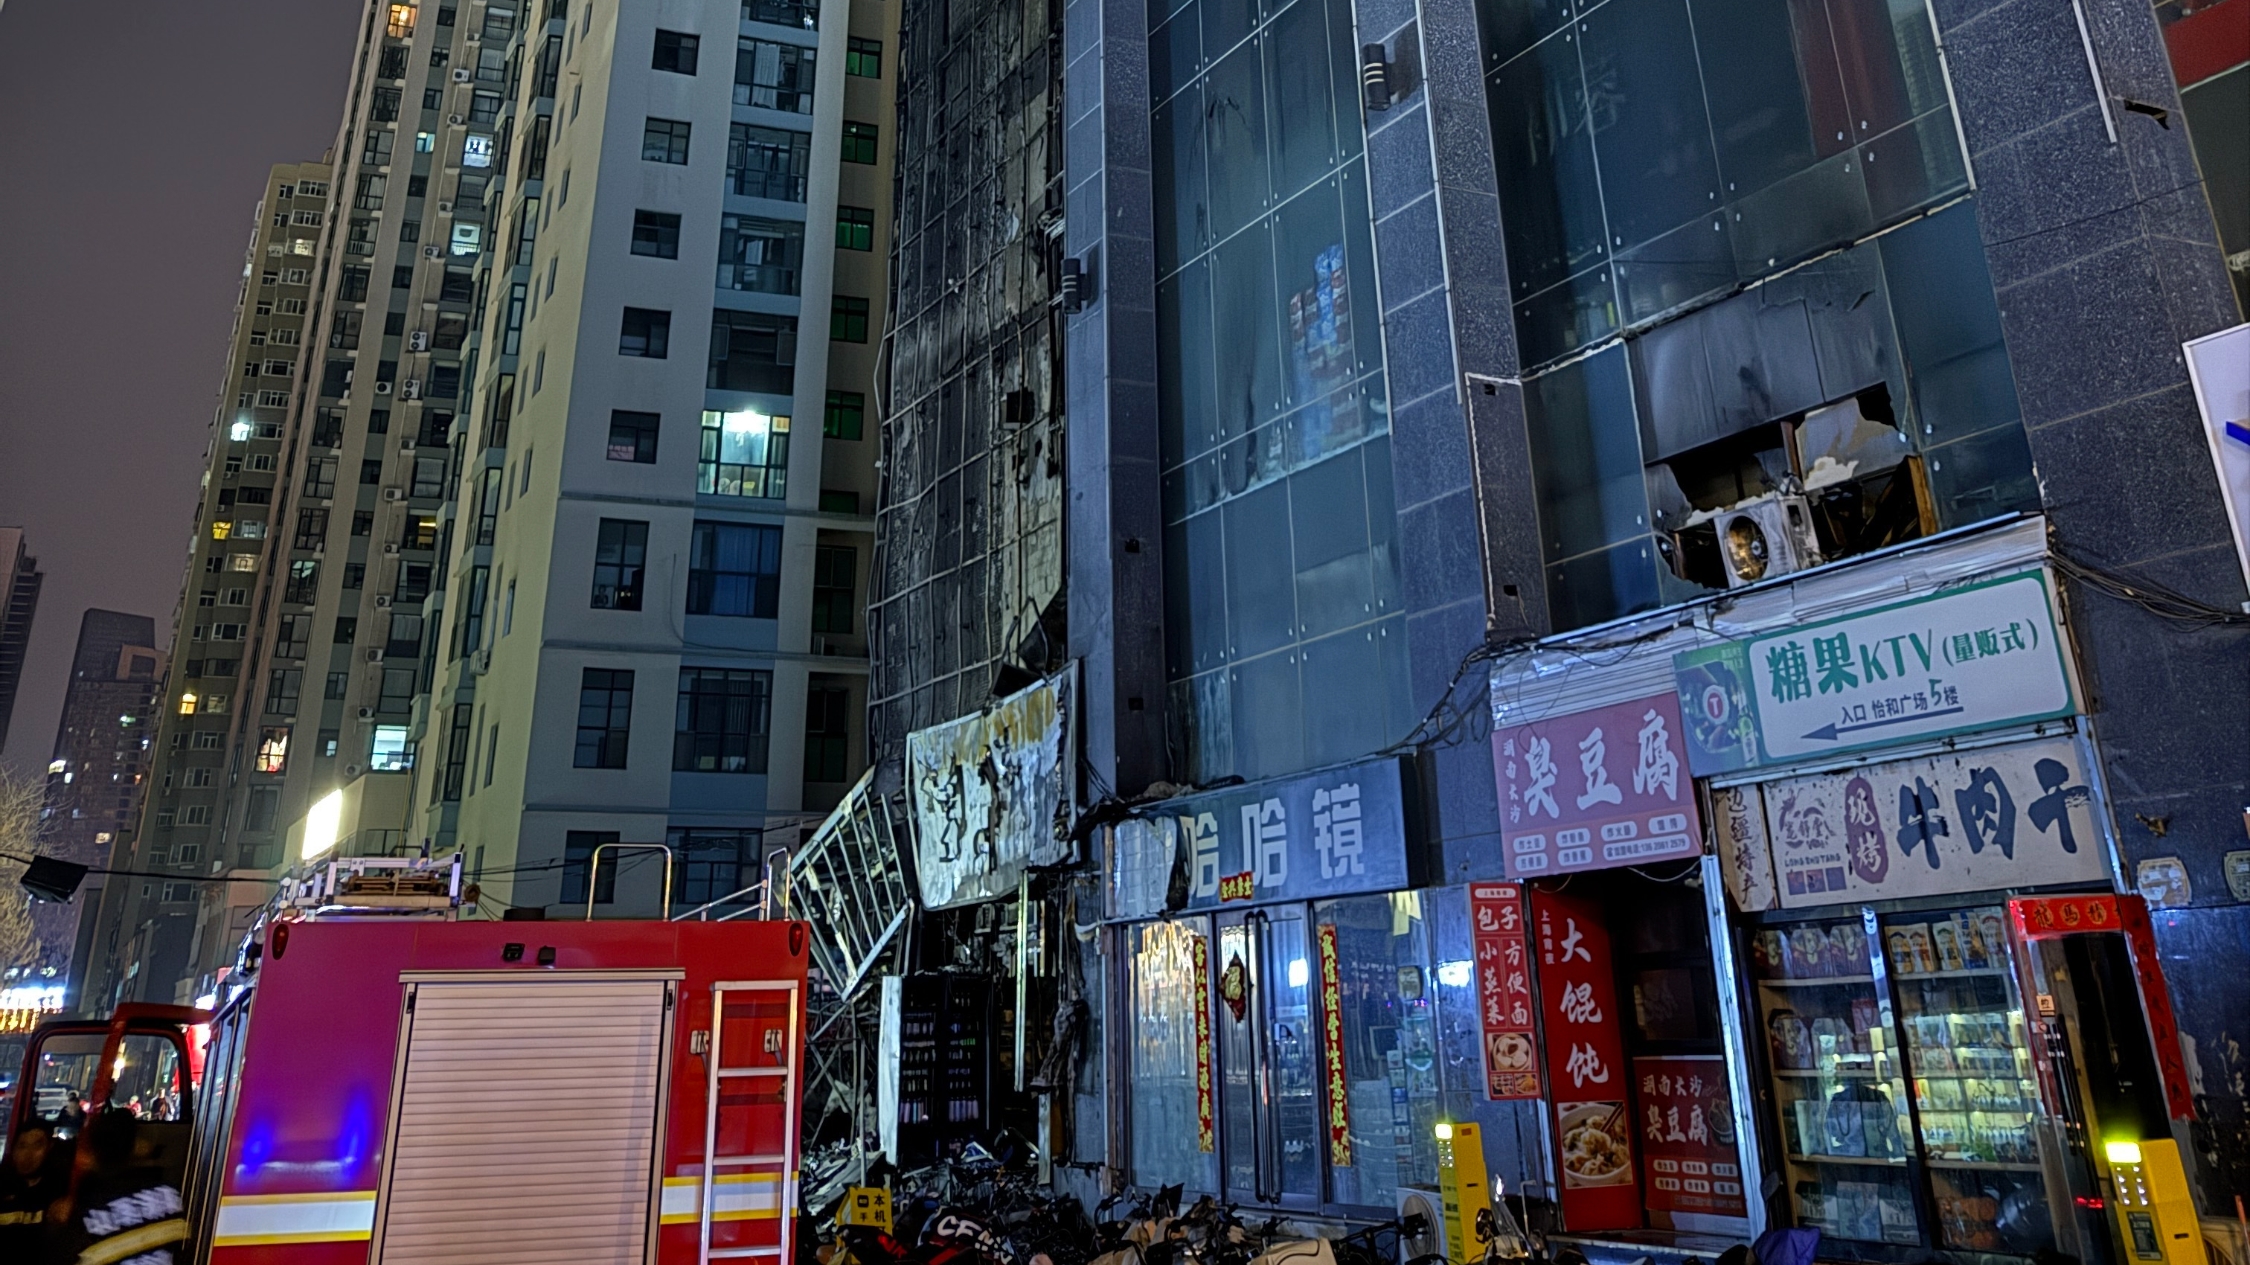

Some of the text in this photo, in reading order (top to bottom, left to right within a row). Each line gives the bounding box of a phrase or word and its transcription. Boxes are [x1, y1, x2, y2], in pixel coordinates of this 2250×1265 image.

[1766, 618, 2039, 704] 糖果KTV(量贩式)
[1841, 677, 1960, 725] 入口 怡和广场5楼
[1524, 708, 1679, 819] 臭豆腐
[1180, 783, 1365, 899] 哈哈镜
[1848, 787, 1882, 873] 现烤
[1896, 758, 2091, 870] 牛肉干
[1477, 904, 1519, 931] 包子
[1504, 940, 1528, 1026] 方便面
[1559, 917, 1610, 1089] 大馄饨
[1647, 1103, 1709, 1147] 臭豆腐
